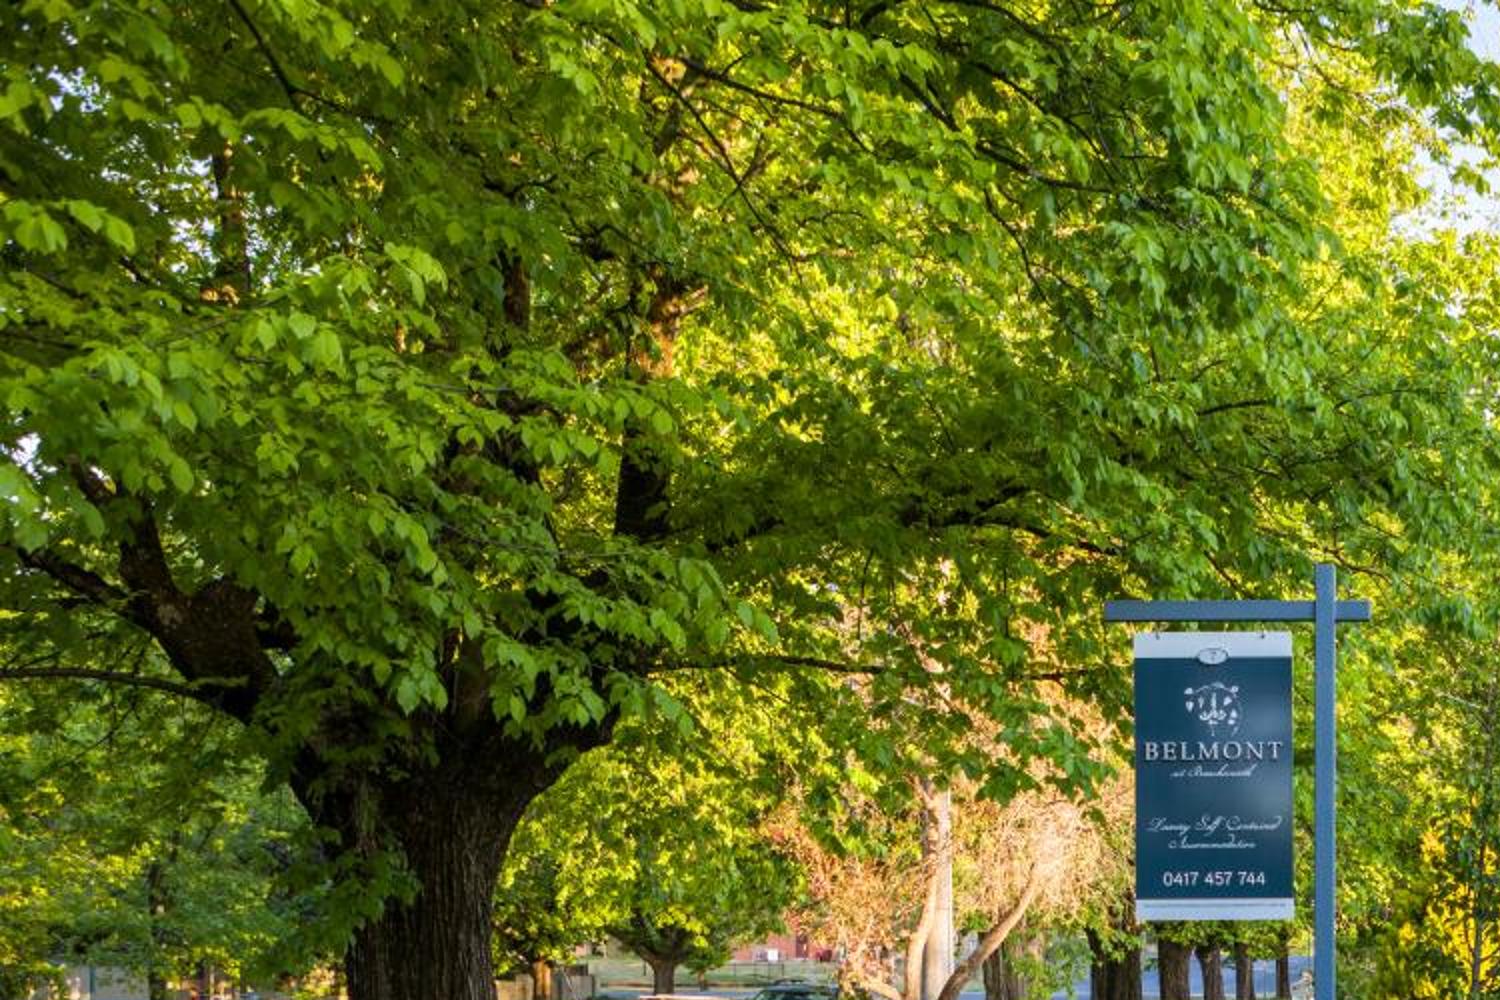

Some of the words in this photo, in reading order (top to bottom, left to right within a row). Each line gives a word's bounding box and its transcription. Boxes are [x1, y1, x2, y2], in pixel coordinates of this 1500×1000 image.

[1145, 741, 1283, 761] BELMONT
[1163, 871, 1199, 887] 0417
[1204, 871, 1233, 886] 457
[1237, 871, 1266, 886] 744
